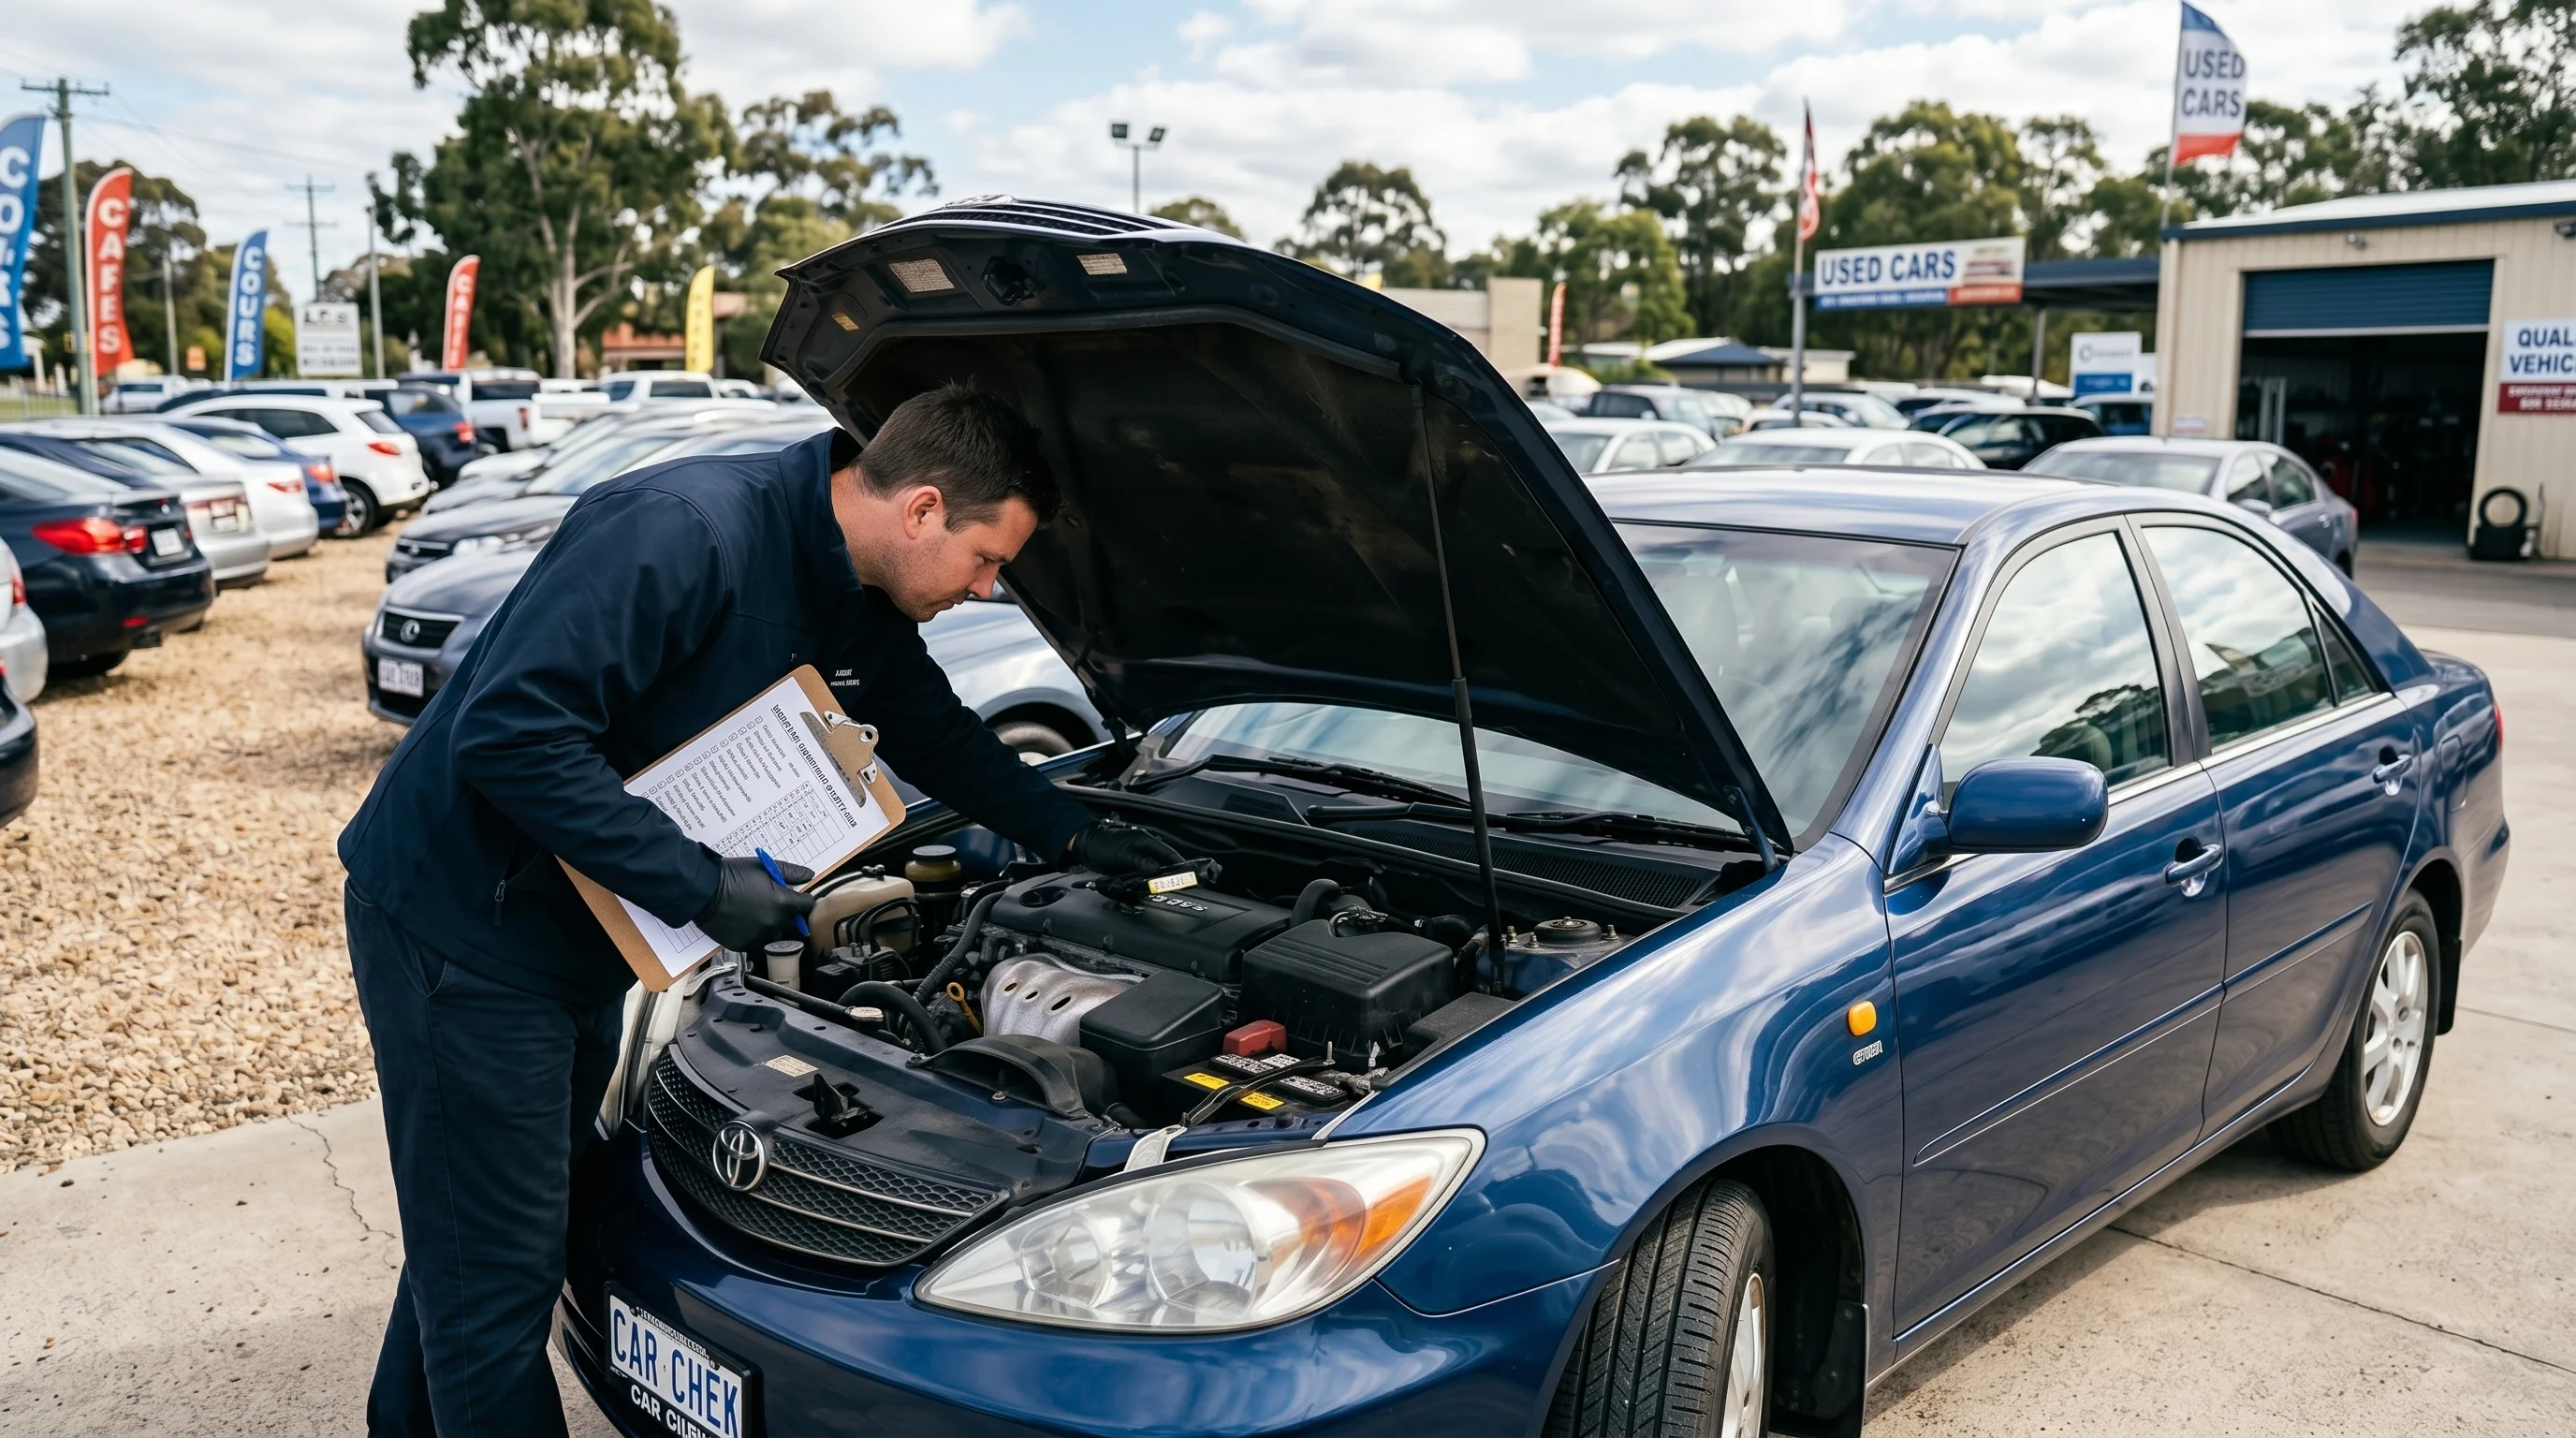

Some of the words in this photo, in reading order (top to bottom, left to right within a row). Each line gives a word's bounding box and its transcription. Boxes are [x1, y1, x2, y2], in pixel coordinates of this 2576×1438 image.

[2184, 50, 2245, 78] USED
[2182, 88, 2240, 117] CARS
[97, 197, 126, 354] CAFES
[1822, 256, 1881, 285] USED
[1891, 250, 1956, 281] CARS
[235, 246, 264, 367] COURS
[2518, 327, 2576, 349] QUAL
[2510, 353, 2576, 374] VEHIC
[613, 1308, 658, 1387] CAR
[671, 1349, 739, 1438] CHEK
[630, 1384, 661, 1421] CAR
